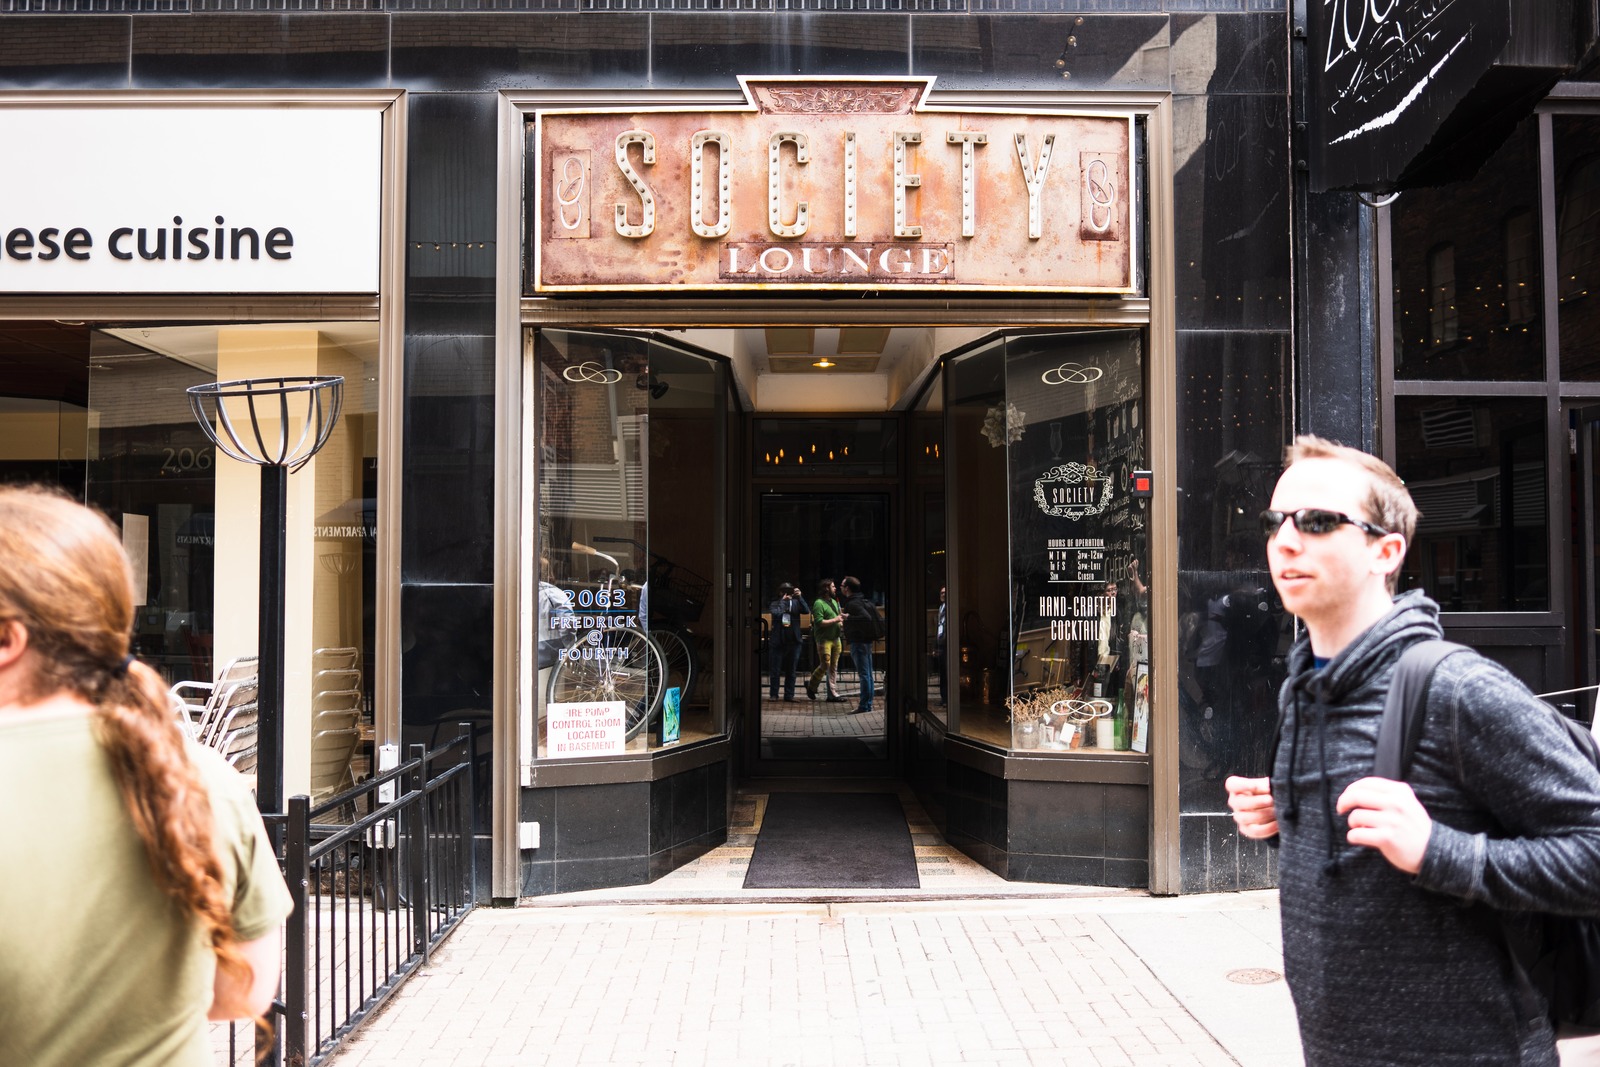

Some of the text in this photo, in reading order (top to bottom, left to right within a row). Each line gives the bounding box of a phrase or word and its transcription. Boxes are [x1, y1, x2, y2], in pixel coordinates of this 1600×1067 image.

[615, 130, 1057, 239] SOCIETY
[0, 215, 294, 260] ese cuisine
[726, 247, 951, 275] LOUNGE
[1052, 487, 1095, 504] SOCIETY
[1063, 507, 1085, 522] Lounge
[1048, 539, 1066, 547] HOURS
[1067, 538, 1074, 547] OF
[1075, 538, 1104, 547] OPERATION
[562, 589, 626, 608] 2063
[1039, 596, 1117, 617] HAND-CRAFTED
[551, 615, 637, 629] FREDRICK
[1051, 619, 1105, 641] COCKTAILS
[587, 629, 604, 646] @
[558, 647, 629, 661] FOURTH
[552, 718, 621, 730] CONTROL ROOM
[567, 729, 606, 740] LOCATED
[557, 740, 616, 752] IN BASEMENT
